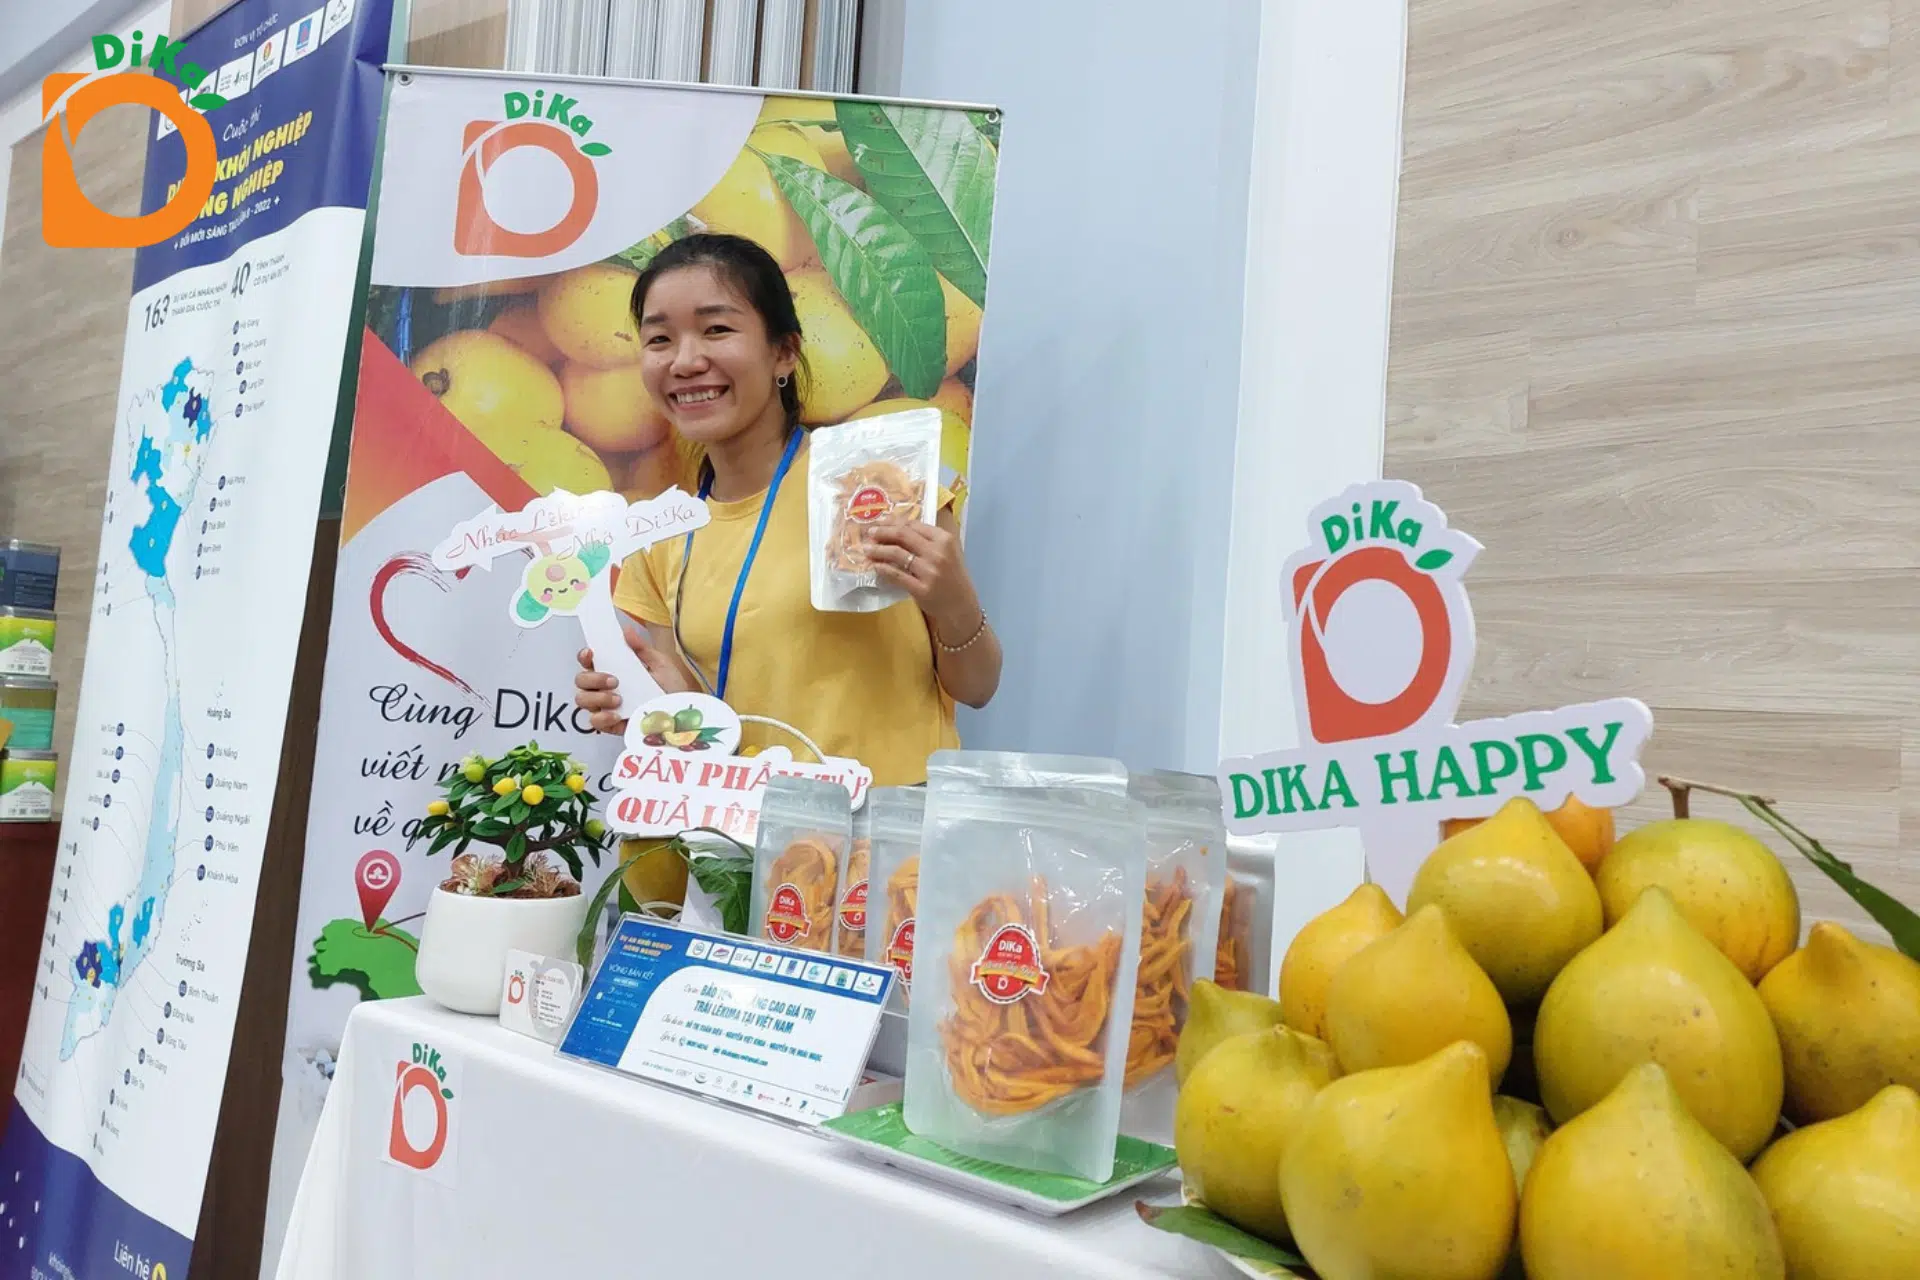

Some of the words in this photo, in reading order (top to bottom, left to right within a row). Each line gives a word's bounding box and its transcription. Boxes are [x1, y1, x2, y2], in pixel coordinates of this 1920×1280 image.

[504, 89, 594, 138] DiKa
[252, 110, 313, 161] NGHIỆP
[231, 159, 284, 209] NGHIỆP
[206, 224, 228, 240] SÁNG
[231, 261, 251, 298] 40
[145, 294, 171, 332] 163
[1320, 500, 1423, 555] DiKa
[369, 682, 483, 740] Cùng
[361, 744, 430, 781] viết
[618, 749, 691, 784] SẢN
[1228, 759, 1360, 820] DIKA
[1374, 721, 1624, 806] HAPPY
[354, 800, 396, 836] về
[617, 795, 690, 828] QUẢ
[197, 960, 205, 972] Sa
[694, 1000, 712, 1014] TRÁI
[756, 1014, 774, 1031] VIỆT
[773, 1018, 795, 1034] NAM
[768, 1000, 786, 1014] CAO
[786, 1002, 802, 1018] GIÁ
[802, 1007, 817, 1024] TRỊ
[412, 1042, 447, 1083] DiKa
[114, 1239, 133, 1273] Liên
